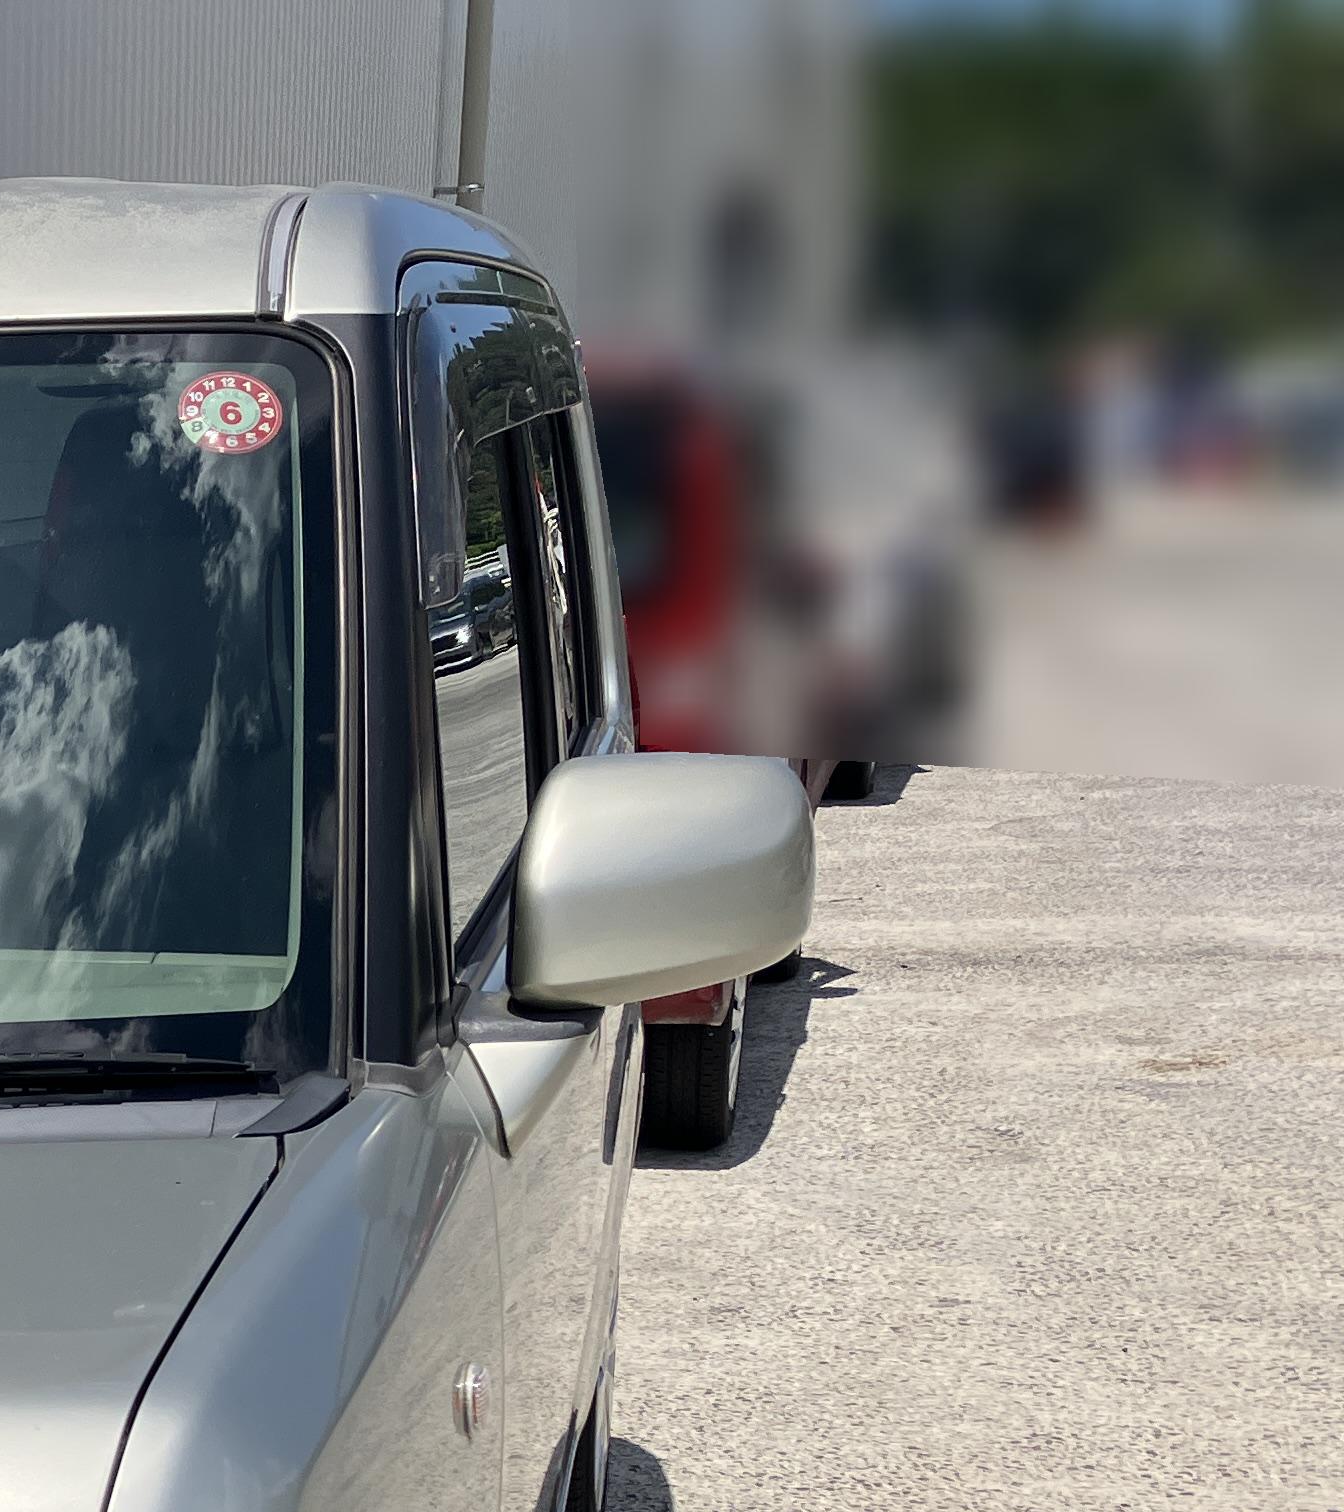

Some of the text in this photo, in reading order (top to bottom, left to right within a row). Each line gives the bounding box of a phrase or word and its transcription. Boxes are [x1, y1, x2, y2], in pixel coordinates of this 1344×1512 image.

[203, 380, 215, 390] 11
[220, 377, 236, 388] 12
[242, 381, 252, 392] 1
[188, 391, 204, 402] 10
[257, 392, 270, 403] 2
[186, 405, 199, 417] 9
[220, 401, 242, 425] 6
[262, 407, 275, 418] 3
[192, 421, 203, 433] 8
[258, 422, 271, 433] 4
[226, 436, 238, 447] 6
[245, 432, 258, 444] 5
